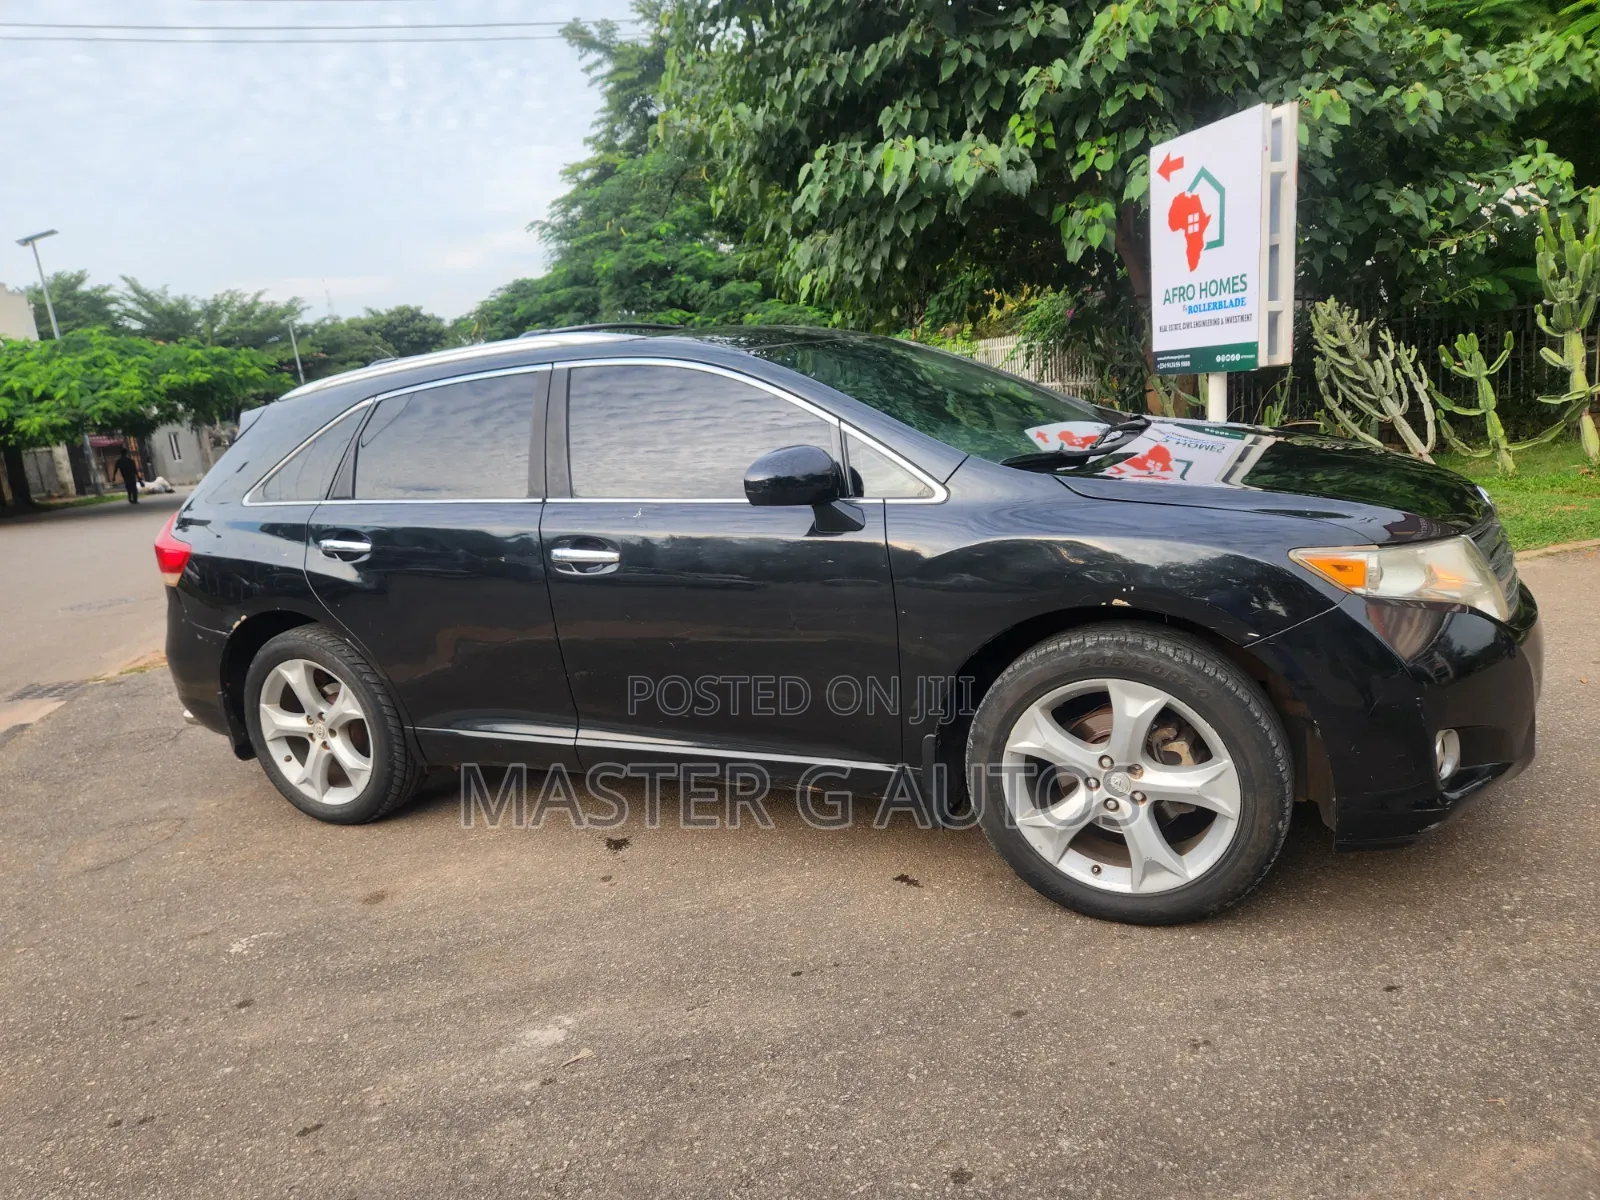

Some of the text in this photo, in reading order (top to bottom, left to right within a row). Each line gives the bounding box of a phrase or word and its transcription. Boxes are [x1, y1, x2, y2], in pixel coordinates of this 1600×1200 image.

[1163, 273, 1248, 305] AFRO HOMES
[1188, 297, 1247, 314] ROLLERBLADE
[1159, 325, 1168, 333] REAL
[1182, 321, 1193, 330] CIVIL
[1193, 318, 1220, 329] ENGINEERING
[1224, 313, 1253, 325] INVESTMENT
